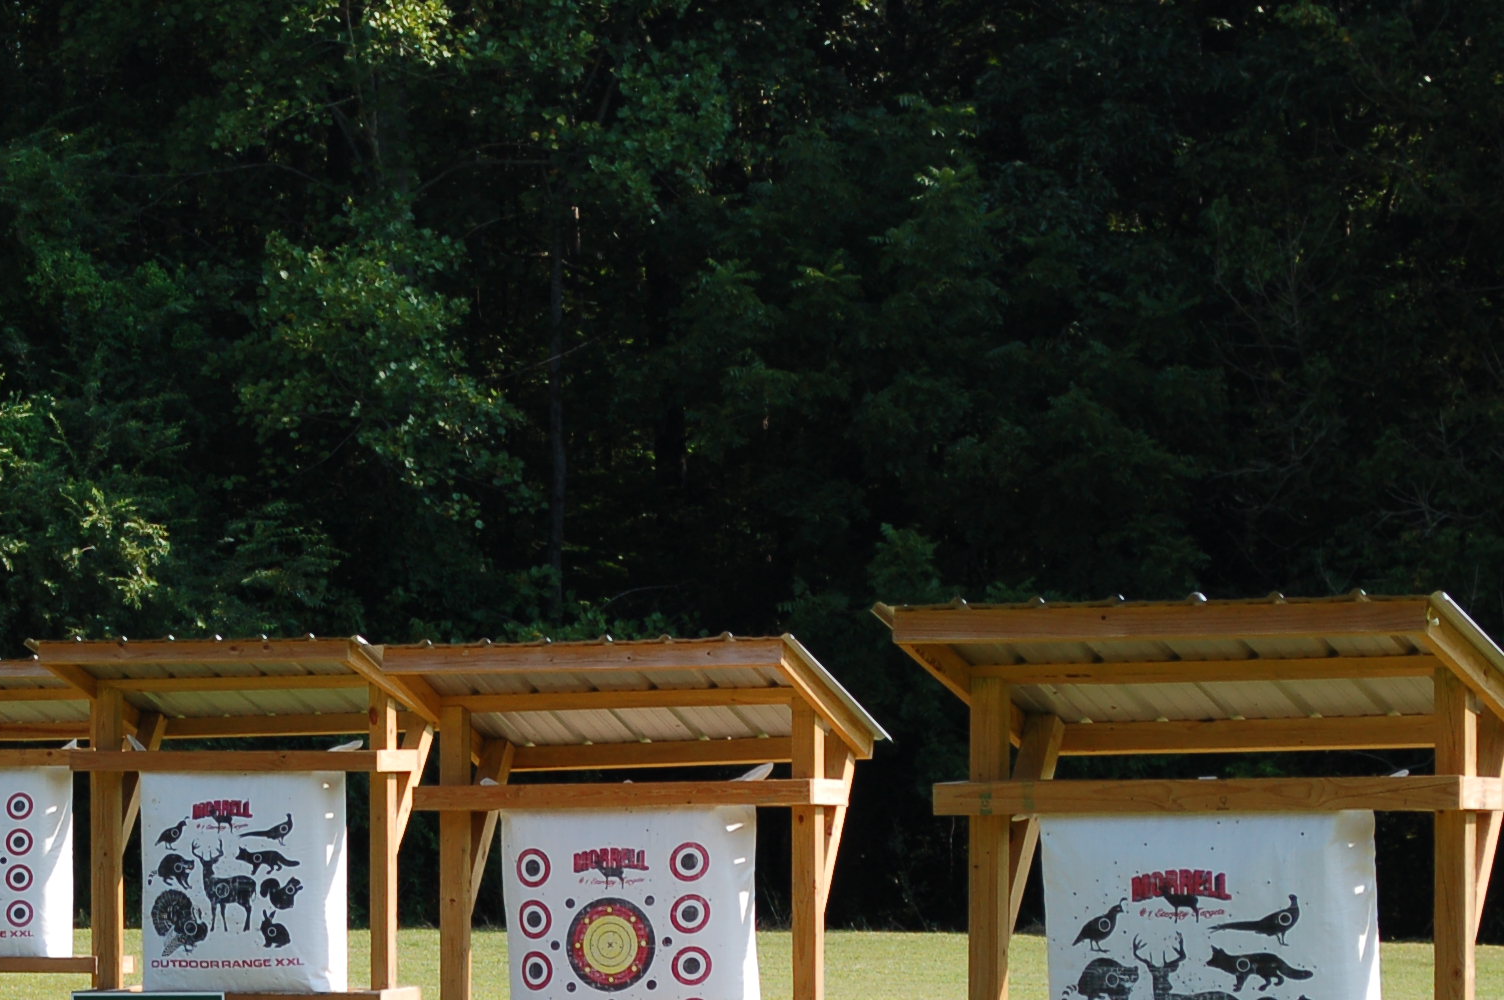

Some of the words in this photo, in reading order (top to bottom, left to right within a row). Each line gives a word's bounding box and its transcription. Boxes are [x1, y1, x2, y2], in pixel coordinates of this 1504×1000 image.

[192, 800, 253, 820] MORRELL
[573, 848, 650, 873] MORRELL
[1132, 869, 1232, 902] MORRELL
[151, 959, 220, 968] OUTDOOR
[222, 958, 272, 968] RANGE
[275, 958, 304, 966] XXL
